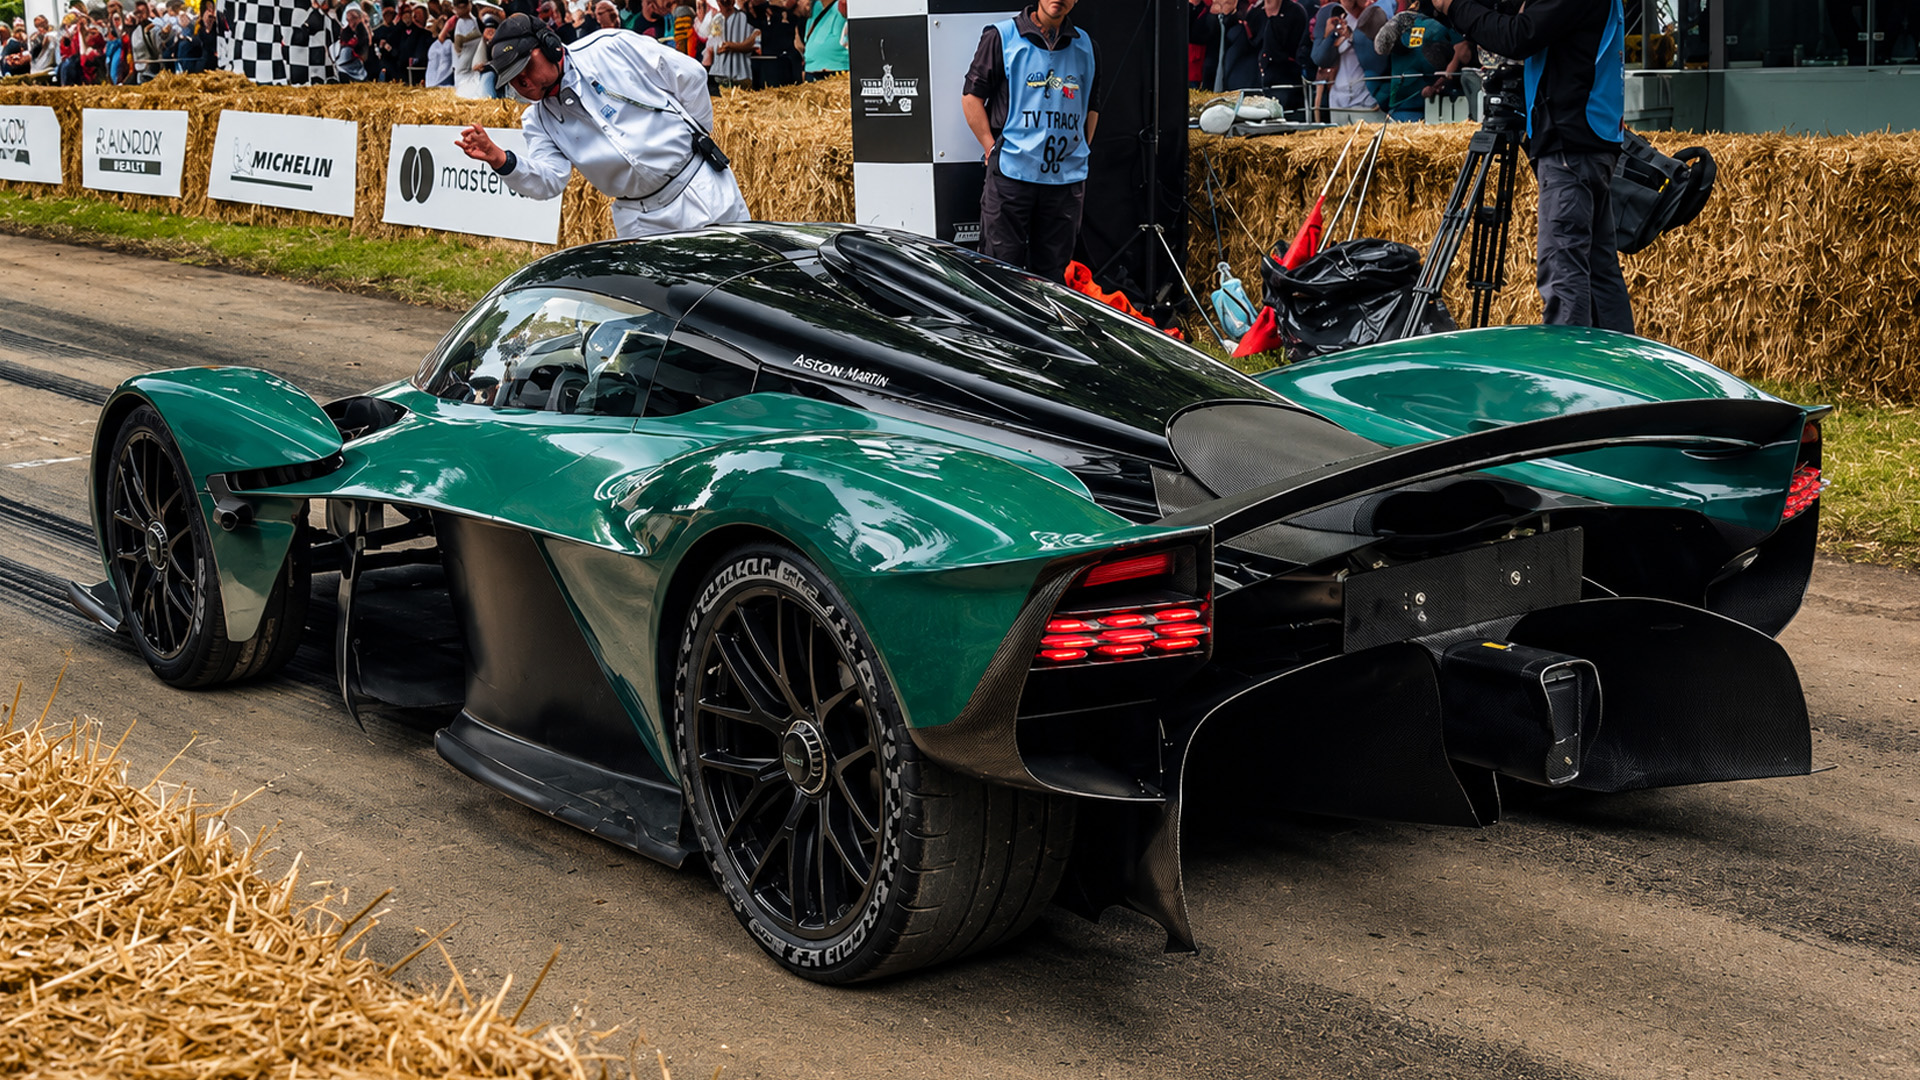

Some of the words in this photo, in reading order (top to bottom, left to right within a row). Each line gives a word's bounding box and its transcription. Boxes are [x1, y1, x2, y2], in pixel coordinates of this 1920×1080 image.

[1022, 111, 1041, 128] TV
[1045, 111, 1080, 131] TRACK
[1043, 135, 1068, 163] 62
[251, 150, 333, 178] MICHELIN
[441, 162, 535, 199] master
[793, 353, 844, 377] ASTON
[844, 367, 889, 387] MARTIN
